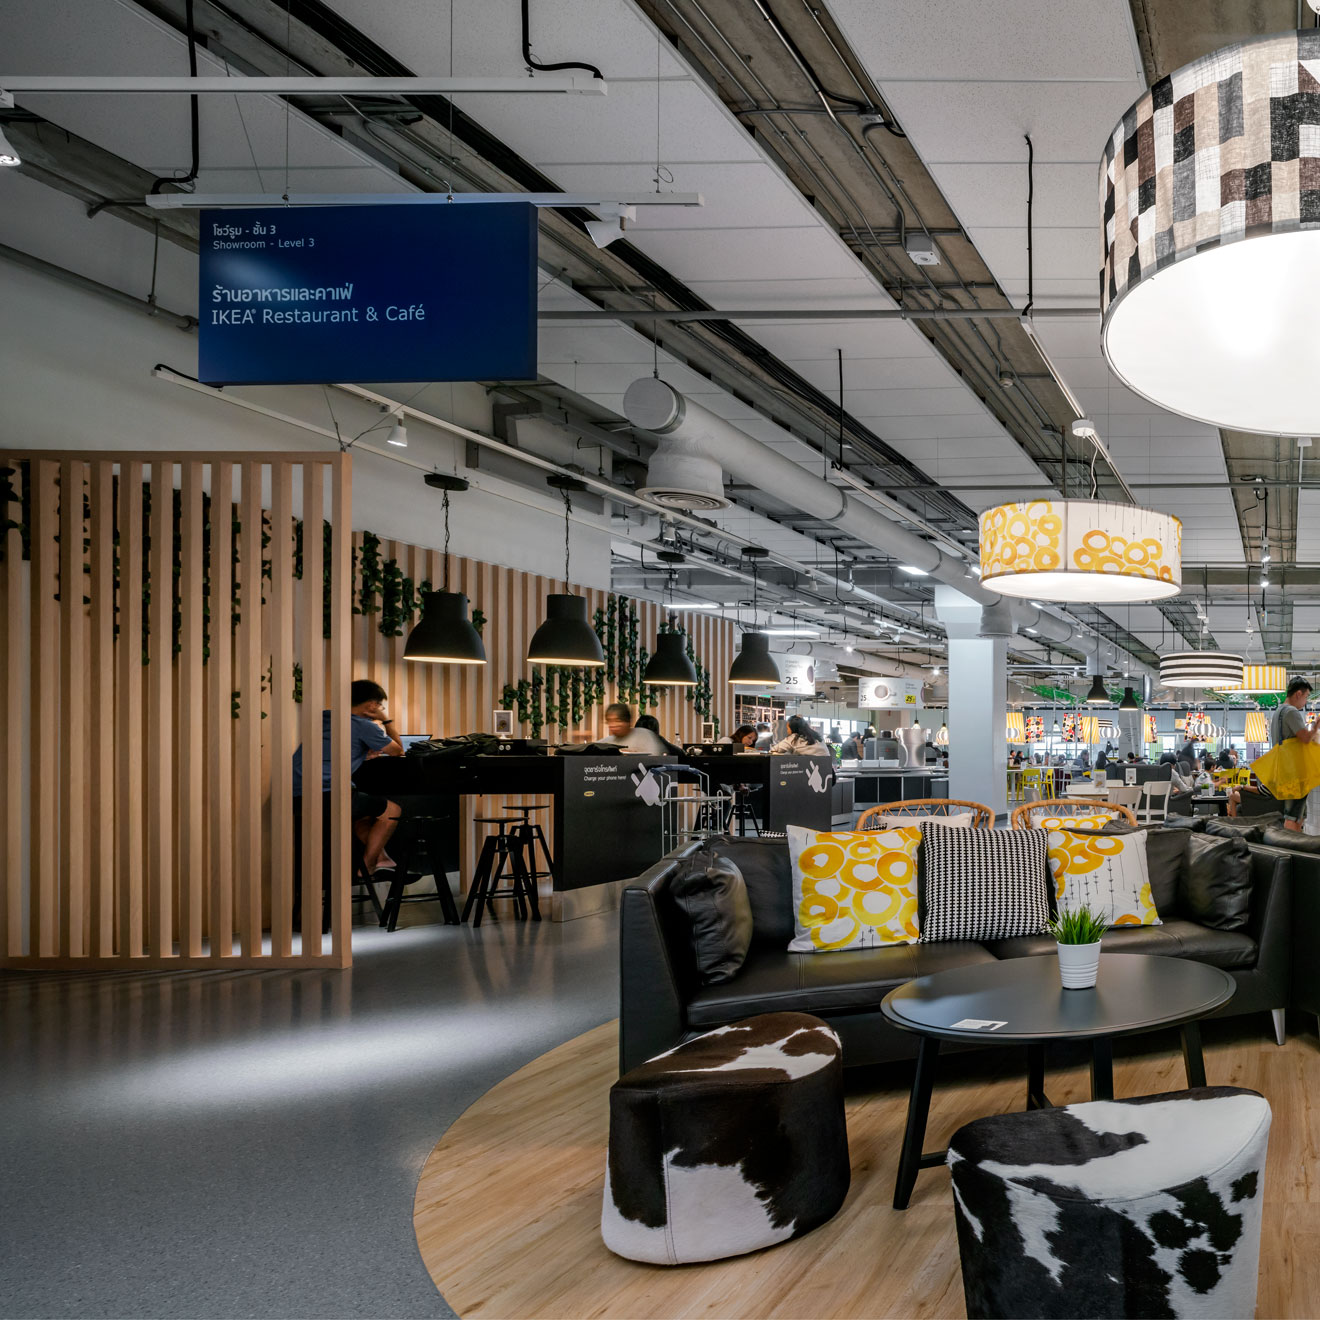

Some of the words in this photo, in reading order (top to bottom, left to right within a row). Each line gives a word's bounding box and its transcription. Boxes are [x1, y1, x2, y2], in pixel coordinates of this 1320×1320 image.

[213, 223, 242, 239] โชว์รูม
[252, 221, 267, 235] ชั้น
[269, 225, 277, 235] 3
[213, 240, 266, 250] Showroom
[278, 238, 304, 248] Level
[308, 238, 315, 247] 3
[212, 282, 354, 303] ร้านอาหารและคาเฟ่
[263, 307, 359, 324] Restaurant
[366, 306, 379, 322] &
[385, 303, 425, 321] Café
[785, 676, 798, 685] 25
